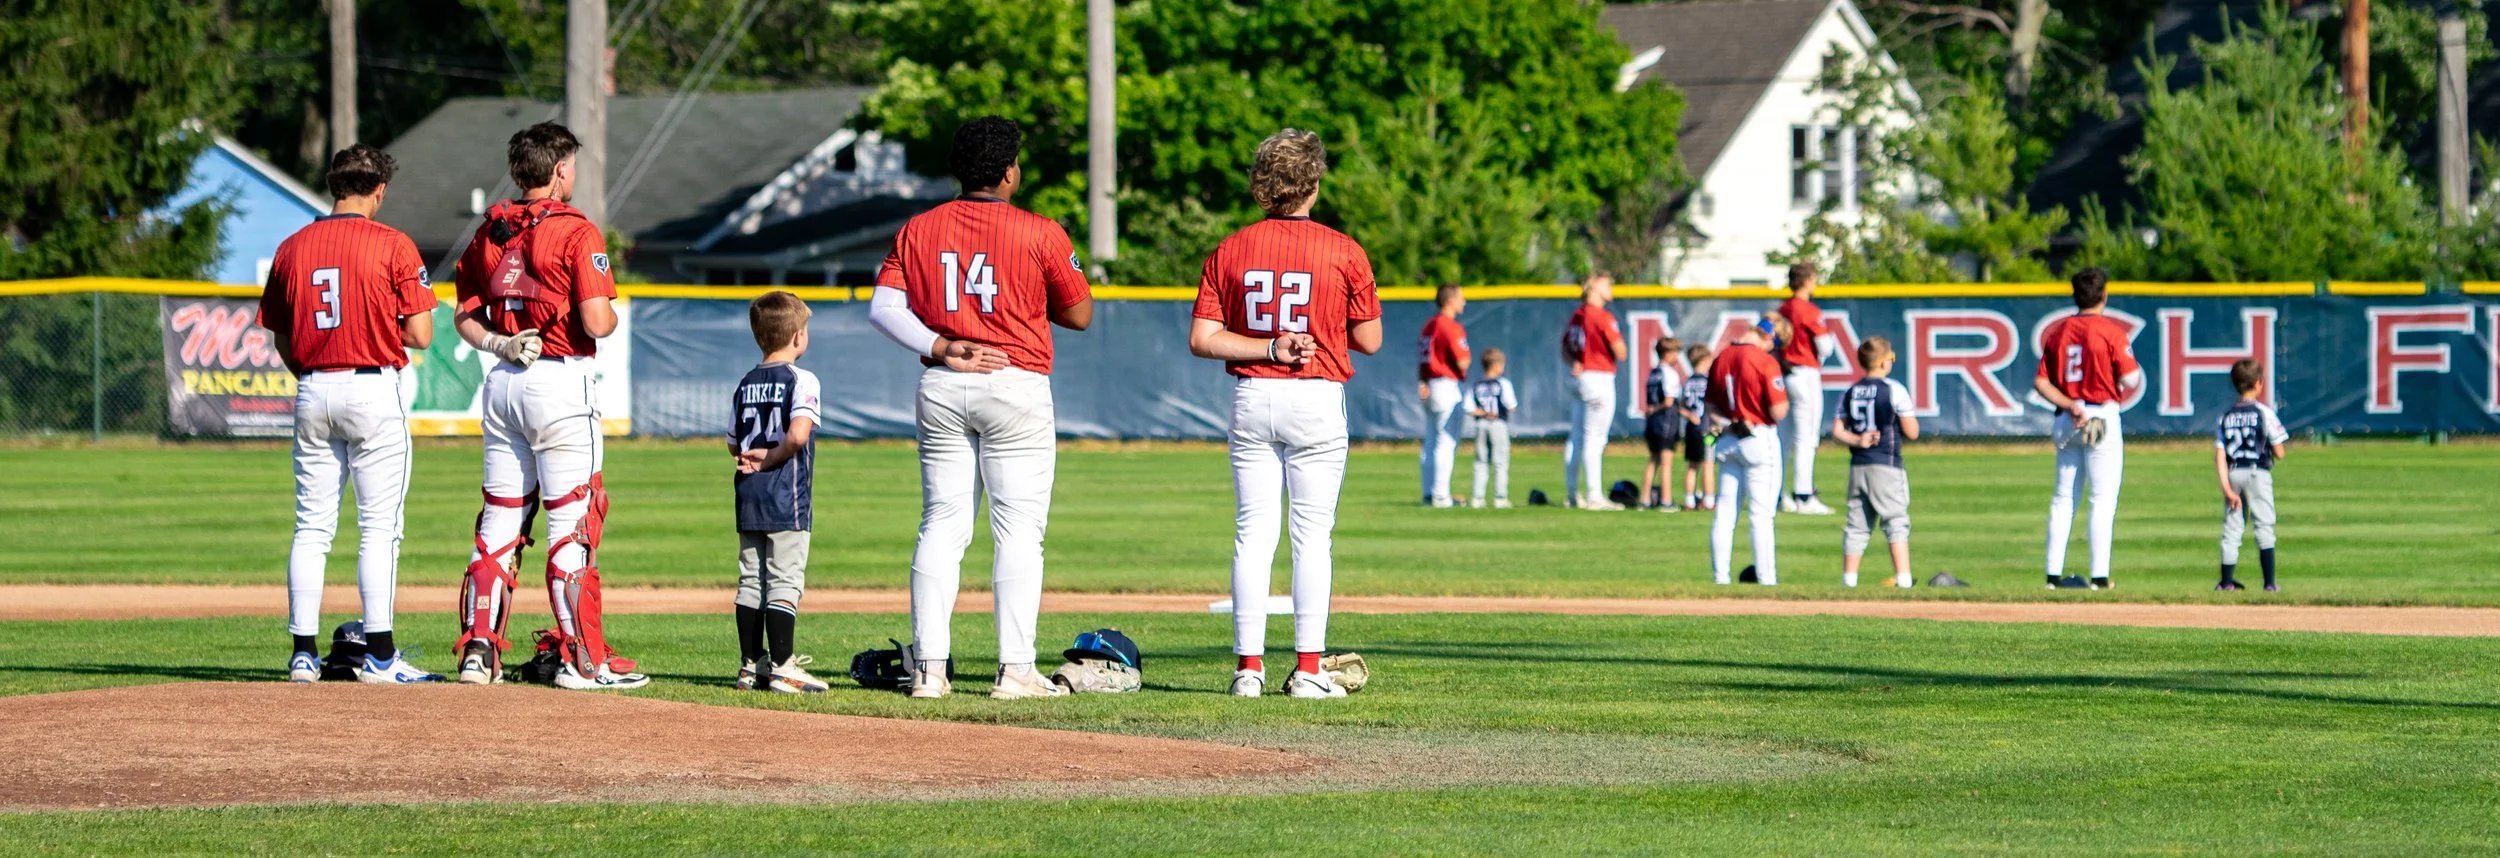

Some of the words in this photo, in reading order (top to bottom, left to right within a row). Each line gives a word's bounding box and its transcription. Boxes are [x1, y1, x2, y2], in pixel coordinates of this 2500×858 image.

[311, 267, 342, 331] 3
[939, 251, 998, 314] 14
[1243, 269, 1313, 333] 22
[2064, 344, 2083, 383] 2
[2364, 303, 2500, 414] F
[740, 406, 787, 453] 24
[1849, 399, 1878, 432] 51
